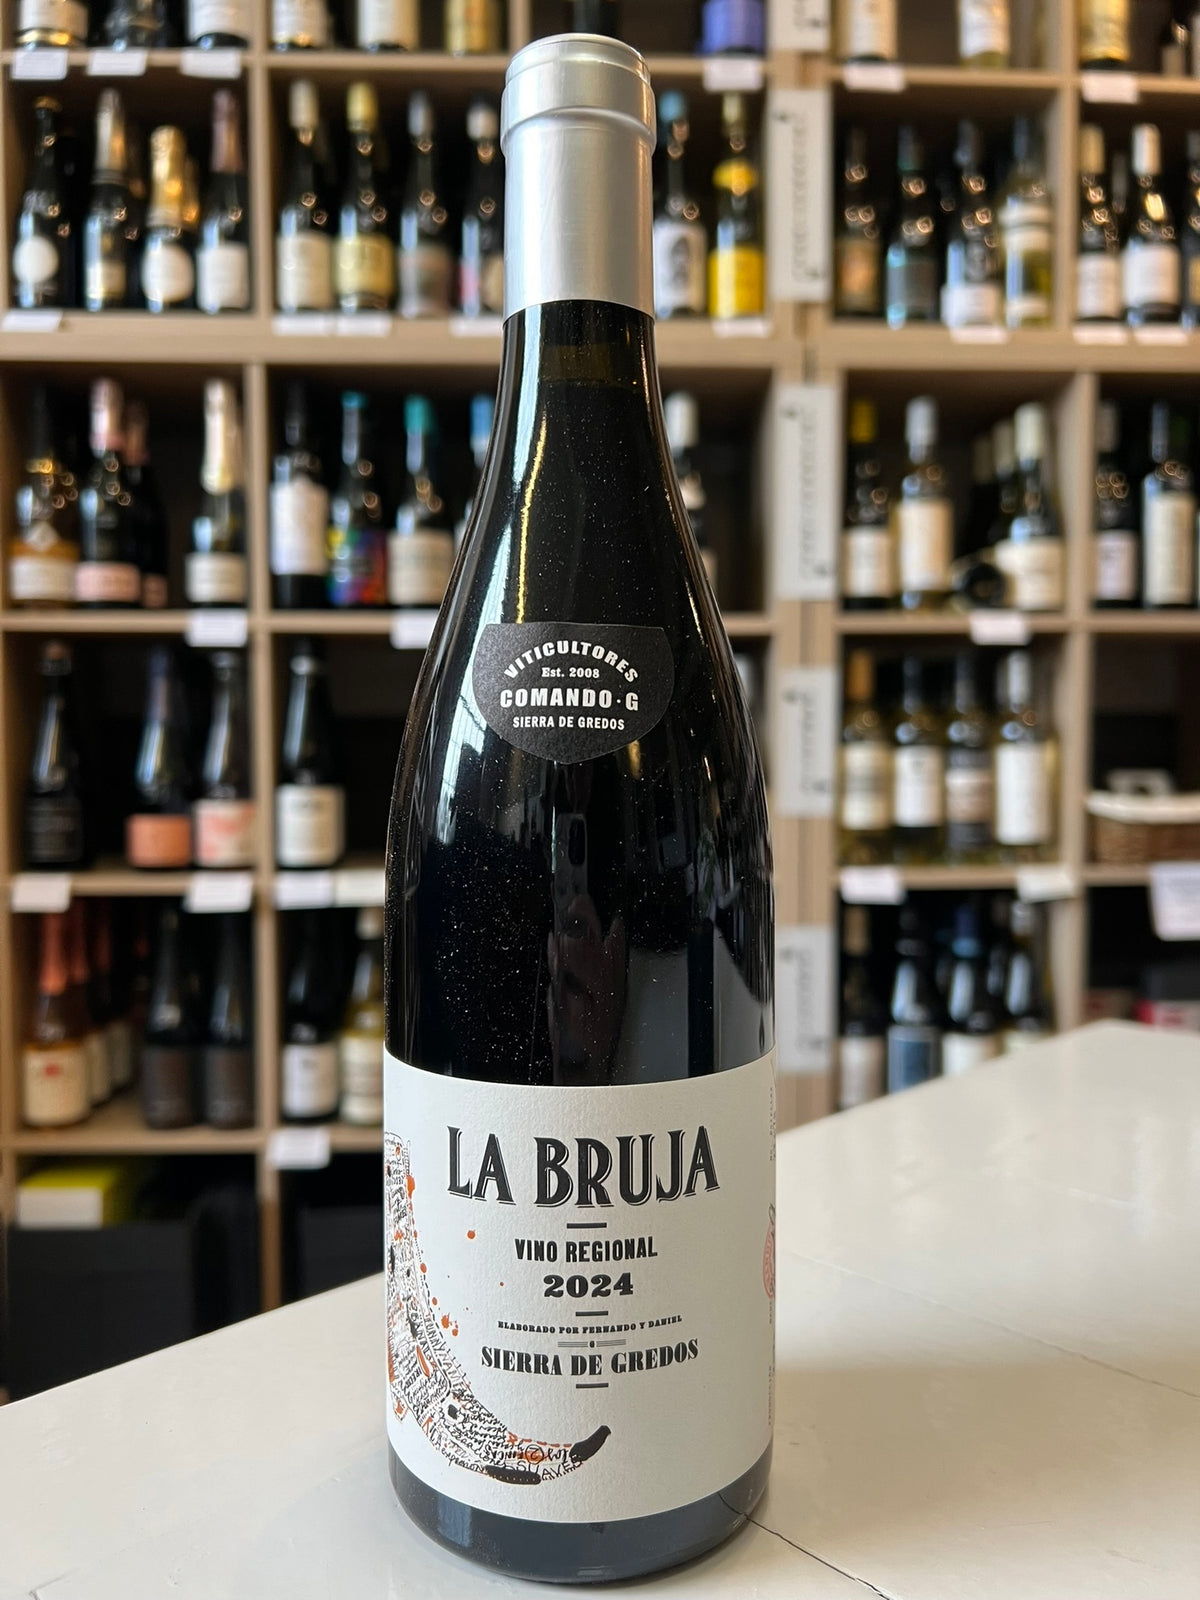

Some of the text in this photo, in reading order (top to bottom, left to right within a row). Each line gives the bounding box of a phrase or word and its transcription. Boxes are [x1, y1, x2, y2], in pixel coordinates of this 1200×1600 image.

[503, 639, 639, 683] VITICULTORES
[541, 667, 600, 679] Est. 2008
[512, 716, 625, 731] SIERRA DE GREDOS
[447, 1125, 720, 1208] LA BRUJA
[515, 1236, 658, 1263] VINO REGIONAL
[543, 1272, 634, 1298] 2024
[498, 1314, 682, 1334] ELABORADO POR FERNANDO Y DANIEL
[481, 1338, 699, 1376] SIERRA DE GREDOS
